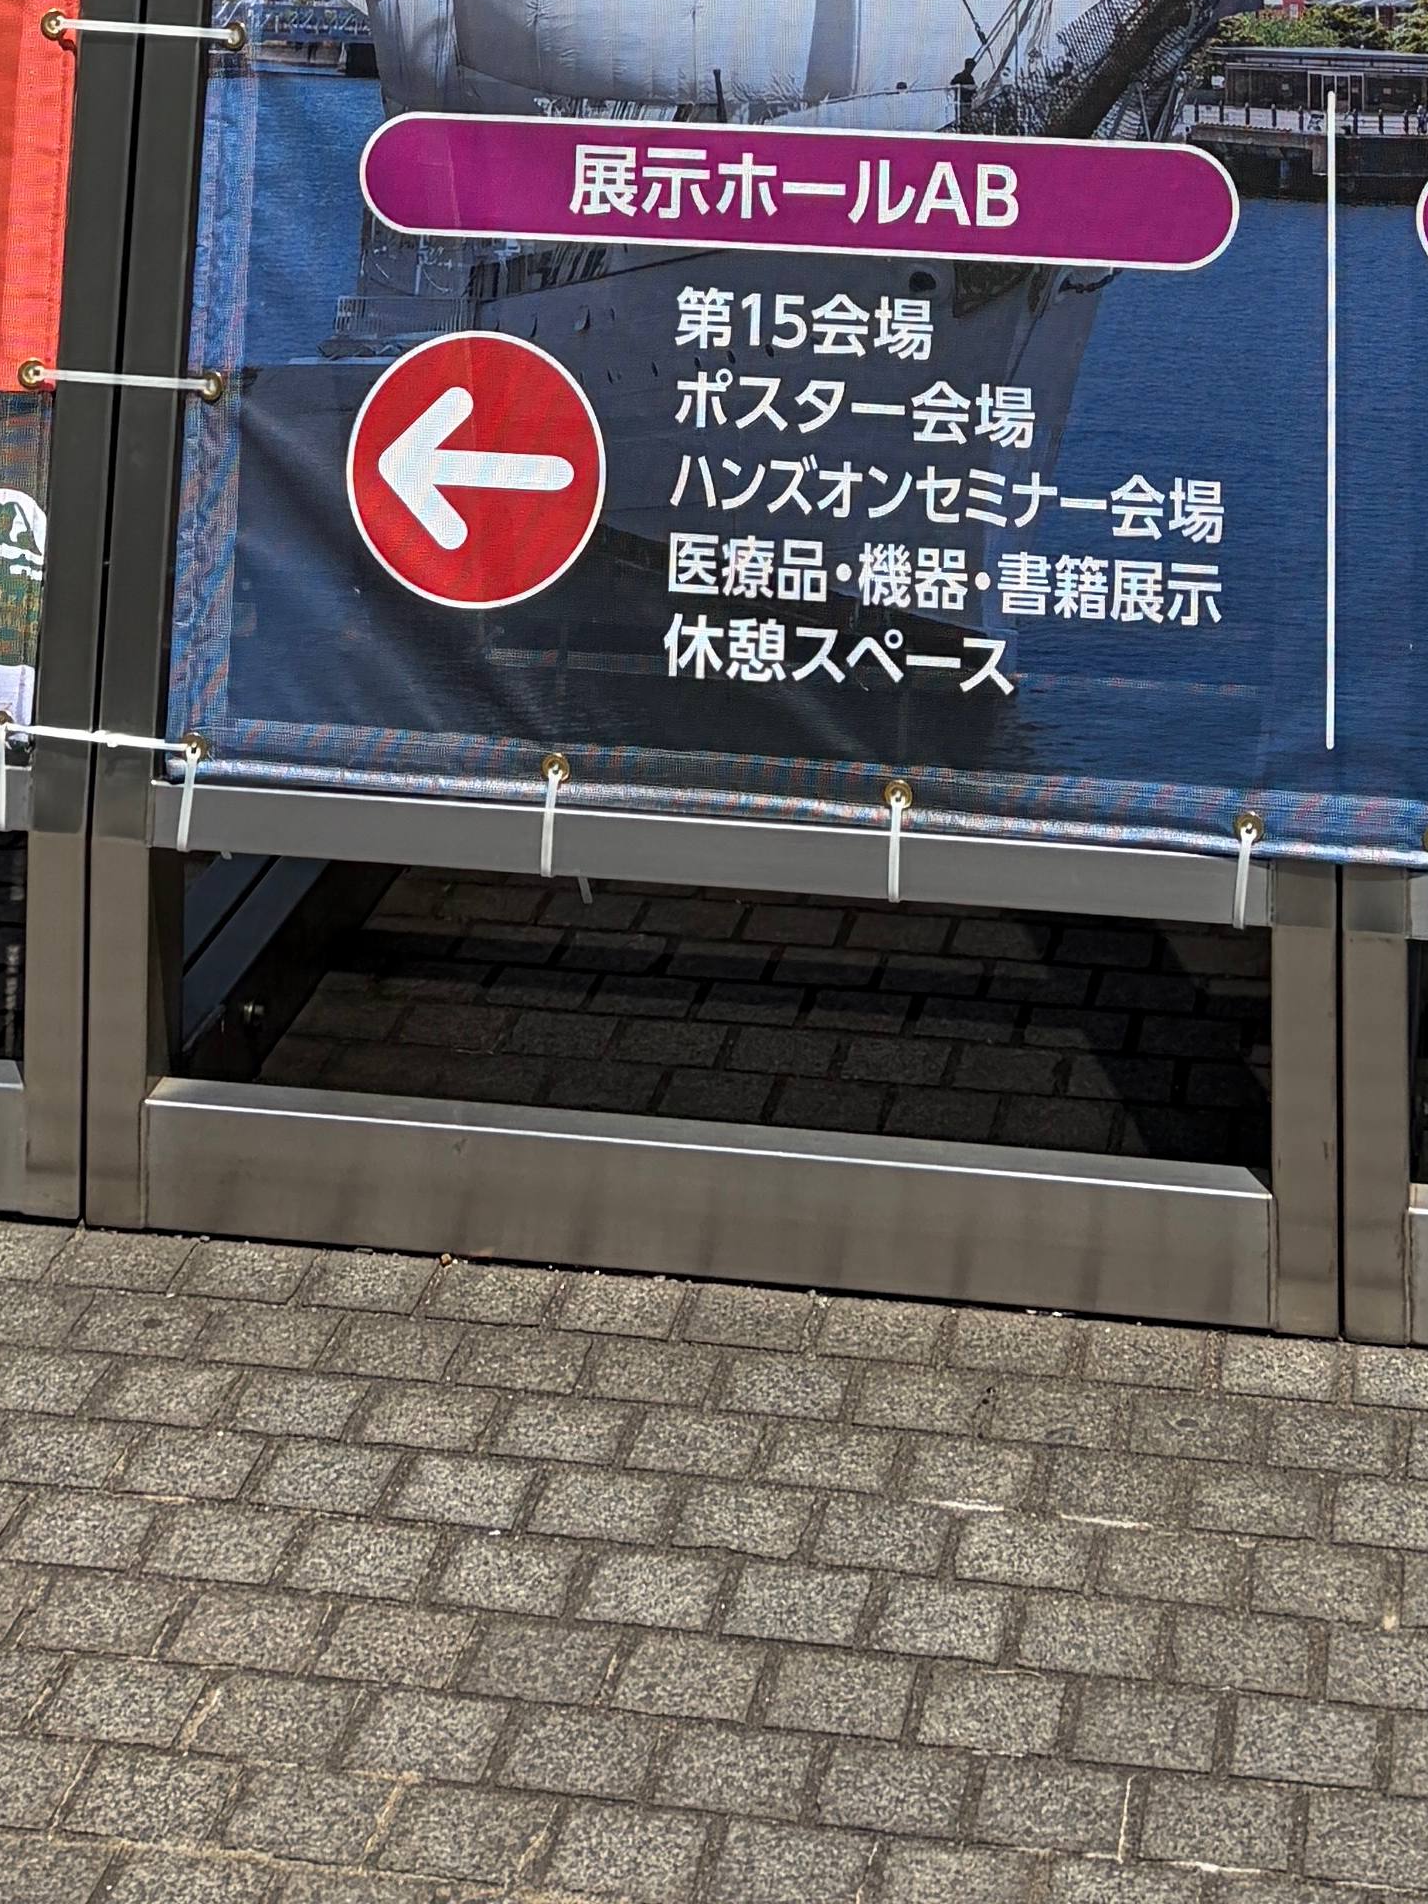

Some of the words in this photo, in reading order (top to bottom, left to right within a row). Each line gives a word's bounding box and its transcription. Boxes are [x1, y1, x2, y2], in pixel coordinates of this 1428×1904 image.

[568, 143, 1019, 228] 展示ホールAB
[674, 287, 934, 361] 第15会場
[674, 370, 1035, 449] ポスター会場
[670, 454, 1225, 545] ハンズオンセミナー会場
[667, 532, 1223, 626] 医療品・機器・書籍展示
[663, 614, 1015, 697] 休憩スペース
